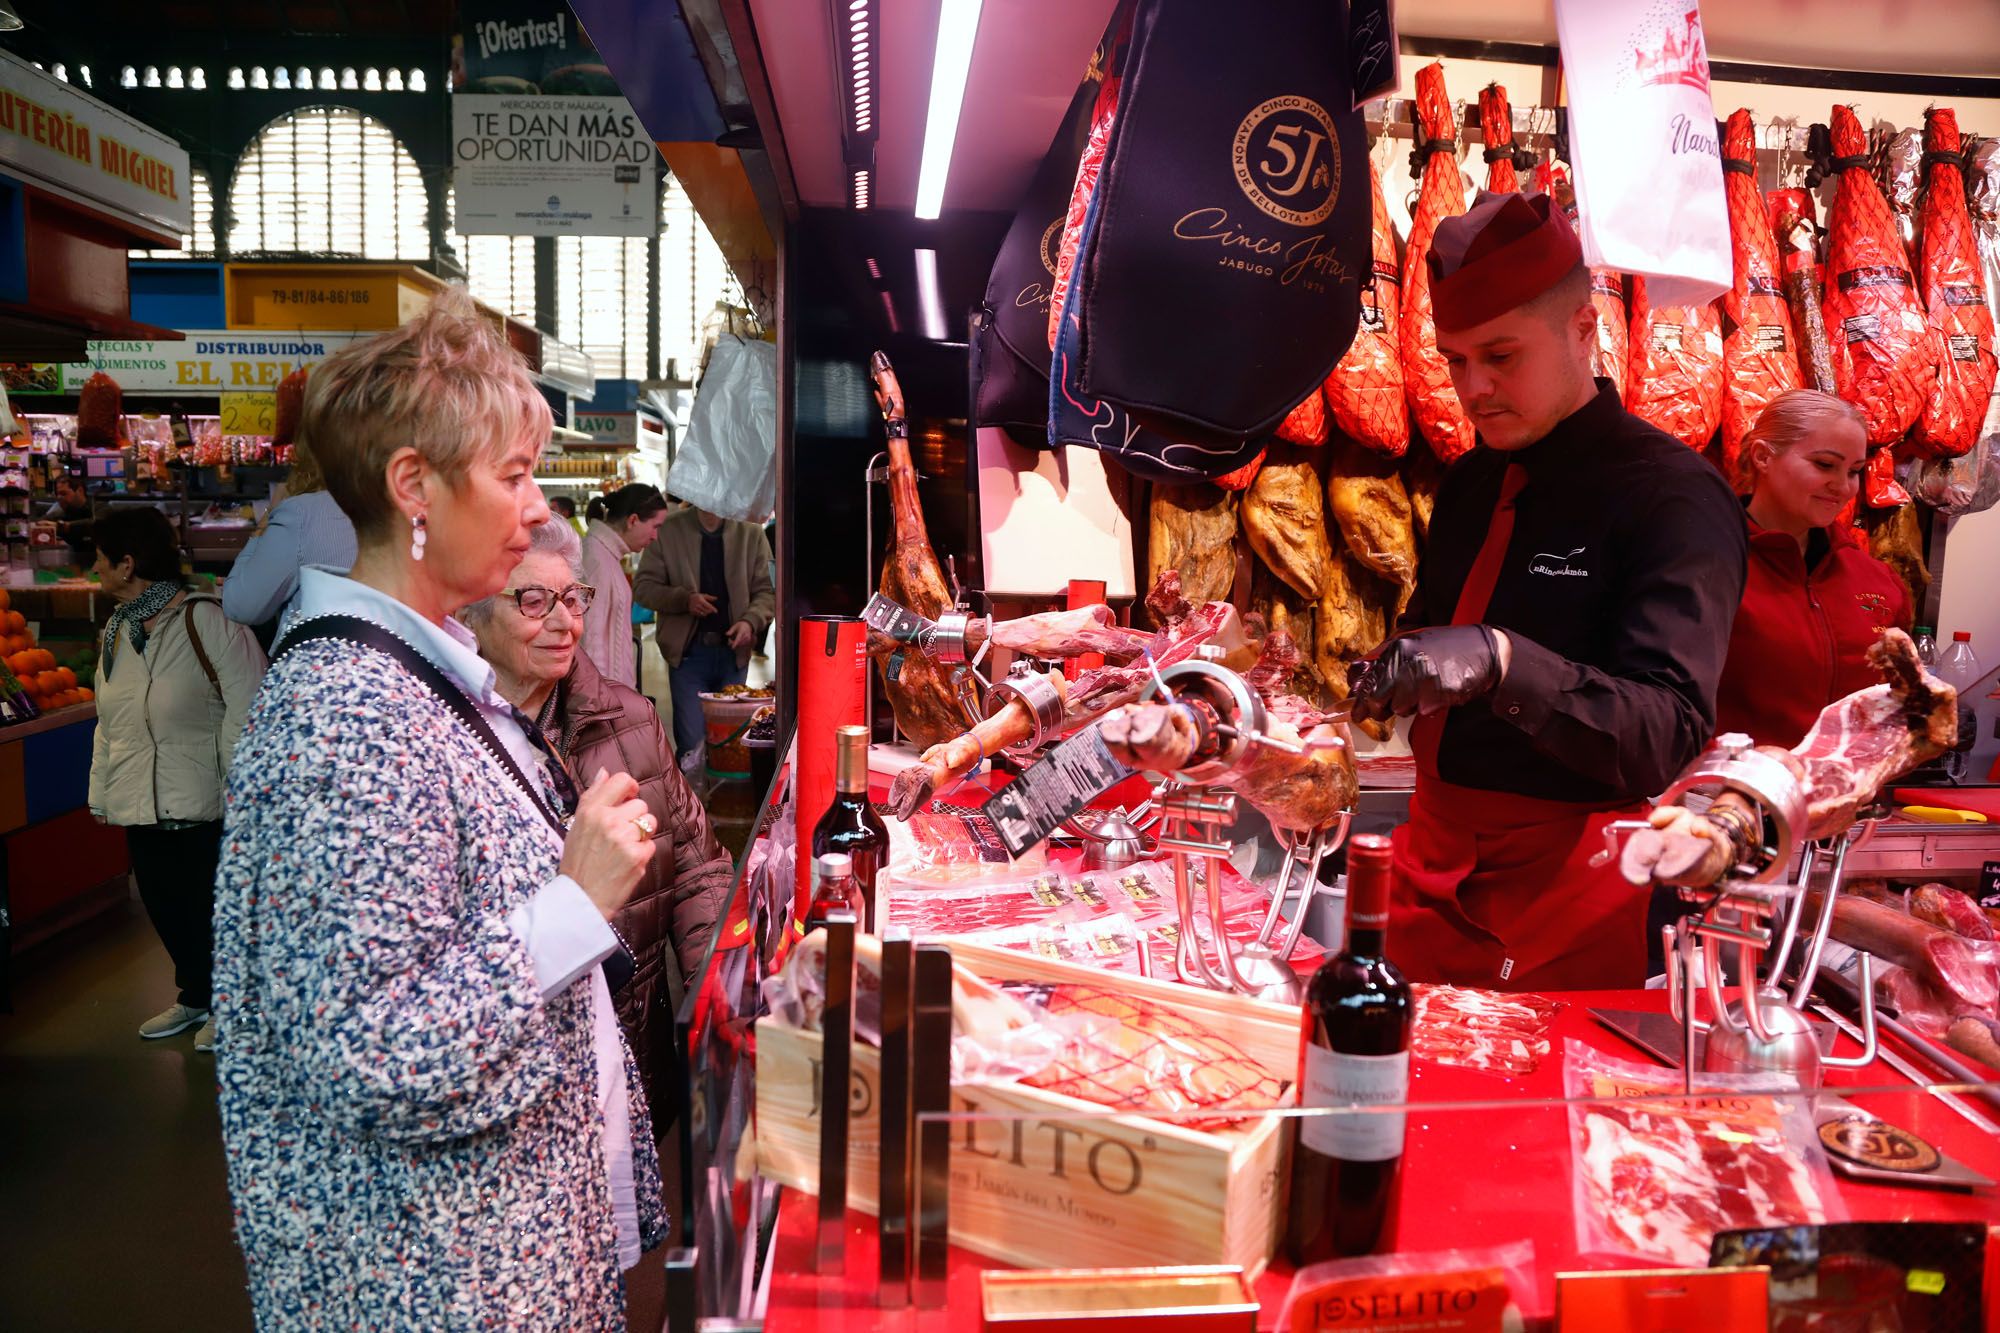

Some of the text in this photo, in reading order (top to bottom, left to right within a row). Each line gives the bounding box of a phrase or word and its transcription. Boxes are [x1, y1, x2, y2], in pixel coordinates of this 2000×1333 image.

[476, 13, 565, 58] ¡Ofertas!
[501, 101, 606, 111] MERCADOS DE MÁLAGA
[1261, 98, 1331, 130] CINCO JOTAS
[472, 109, 635, 138] TE DAN MÁS
[457, 138, 650, 163] OPORTUNIDAD
[1260, 124, 1327, 197] 5J
[100, 138, 178, 201] MIGUEL
[1238, 168, 1251, 187] DE
[1249, 189, 1302, 223] BELLOTA
[1312, 199, 1334, 221] 100%
[1173, 208, 1281, 254] Cinco
[1219, 256, 1274, 276] JABUGO
[1281, 234, 1353, 285] Jotas
[272, 289, 369, 304] 79-81/84-86/186
[87, 341, 155, 353] SPECIAS Y
[196, 342, 325, 355] DISTRIBUIDOR
[69, 359, 166, 370] CONDIMENTOS
[175, 361, 220, 386] EL
[223, 406, 240, 431] 2
[1313, 1289, 1477, 1328] JOSELITO
